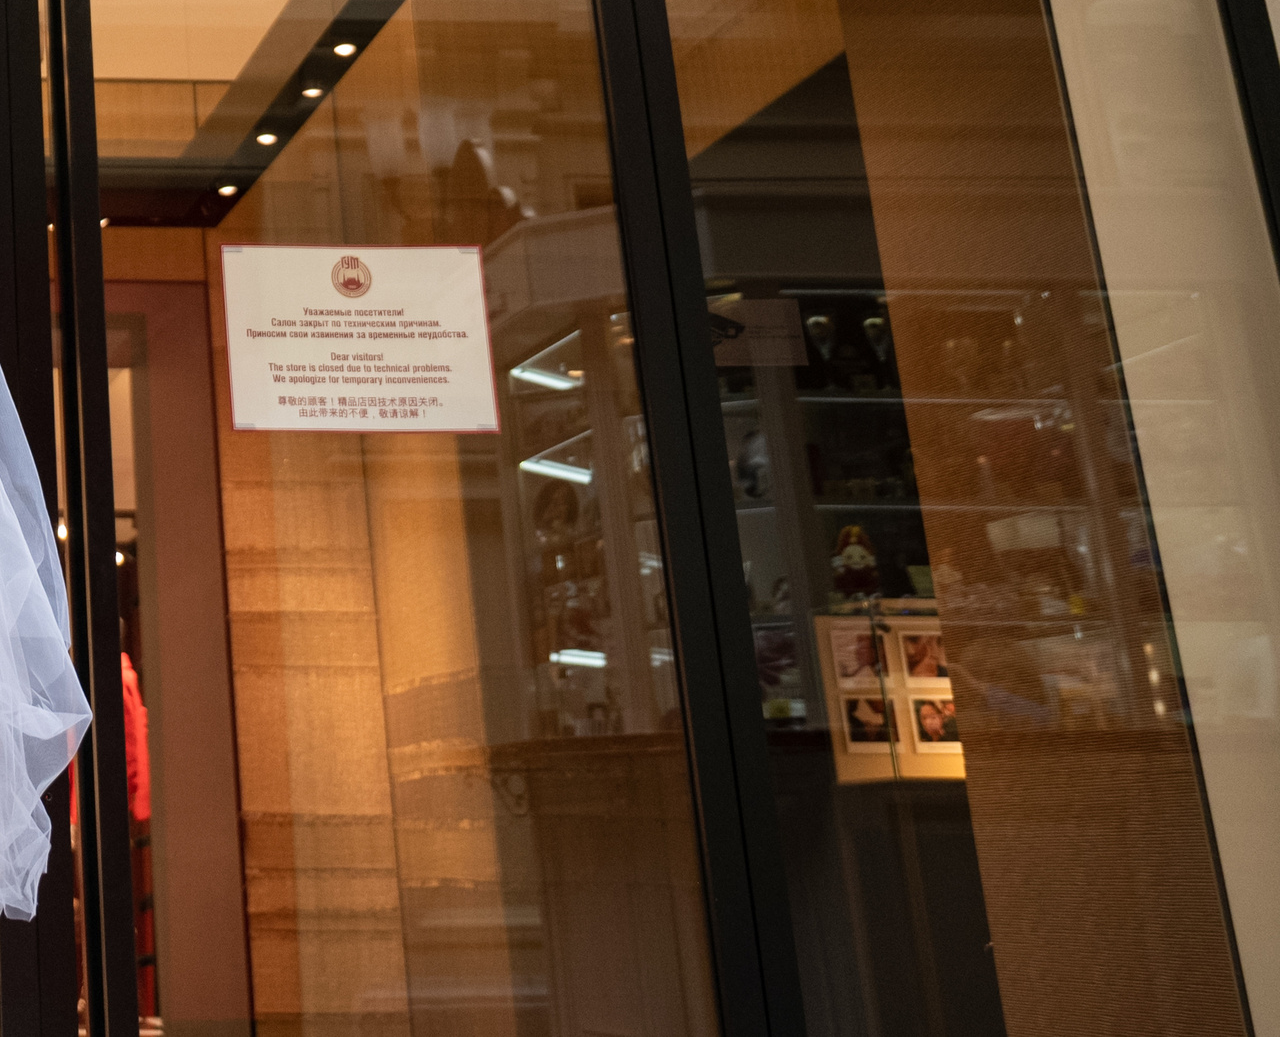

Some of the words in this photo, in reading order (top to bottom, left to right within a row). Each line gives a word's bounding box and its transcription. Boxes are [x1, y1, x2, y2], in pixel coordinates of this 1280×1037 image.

[303, 306, 352, 317] Уважаемые
[354, 307, 404, 317] посетители!
[271, 317, 297, 328] Салон
[299, 318, 329, 330] закрыт
[332, 320, 341, 328] по
[344, 320, 396, 328] техническим
[399, 319, 441, 330] причинам.
[246, 328, 287, 340] Приносим
[289, 330, 308, 339] свои
[311, 330, 354, 340] извинения
[356, 331, 366, 340] за
[368, 331, 415, 341] временные
[418, 329, 468, 341] неудобства.
[331, 351, 349, 362] Dear
[352, 352, 384, 362] visitors!
[268, 362, 283, 372] The
[286, 363, 306, 373] store
[309, 362, 316, 373] is
[318, 363, 344, 373] closed
[347, 363, 361, 373] due
[363, 363, 371, 373] to
[374, 363, 410, 373] technical
[412, 363, 452, 375] problems.
[272, 373, 286, 384] We
[289, 373, 326, 386] apologize
[329, 374, 339, 384] for
[342, 375, 382, 386] temporary
[385, 374, 449, 385] inconveniences.
